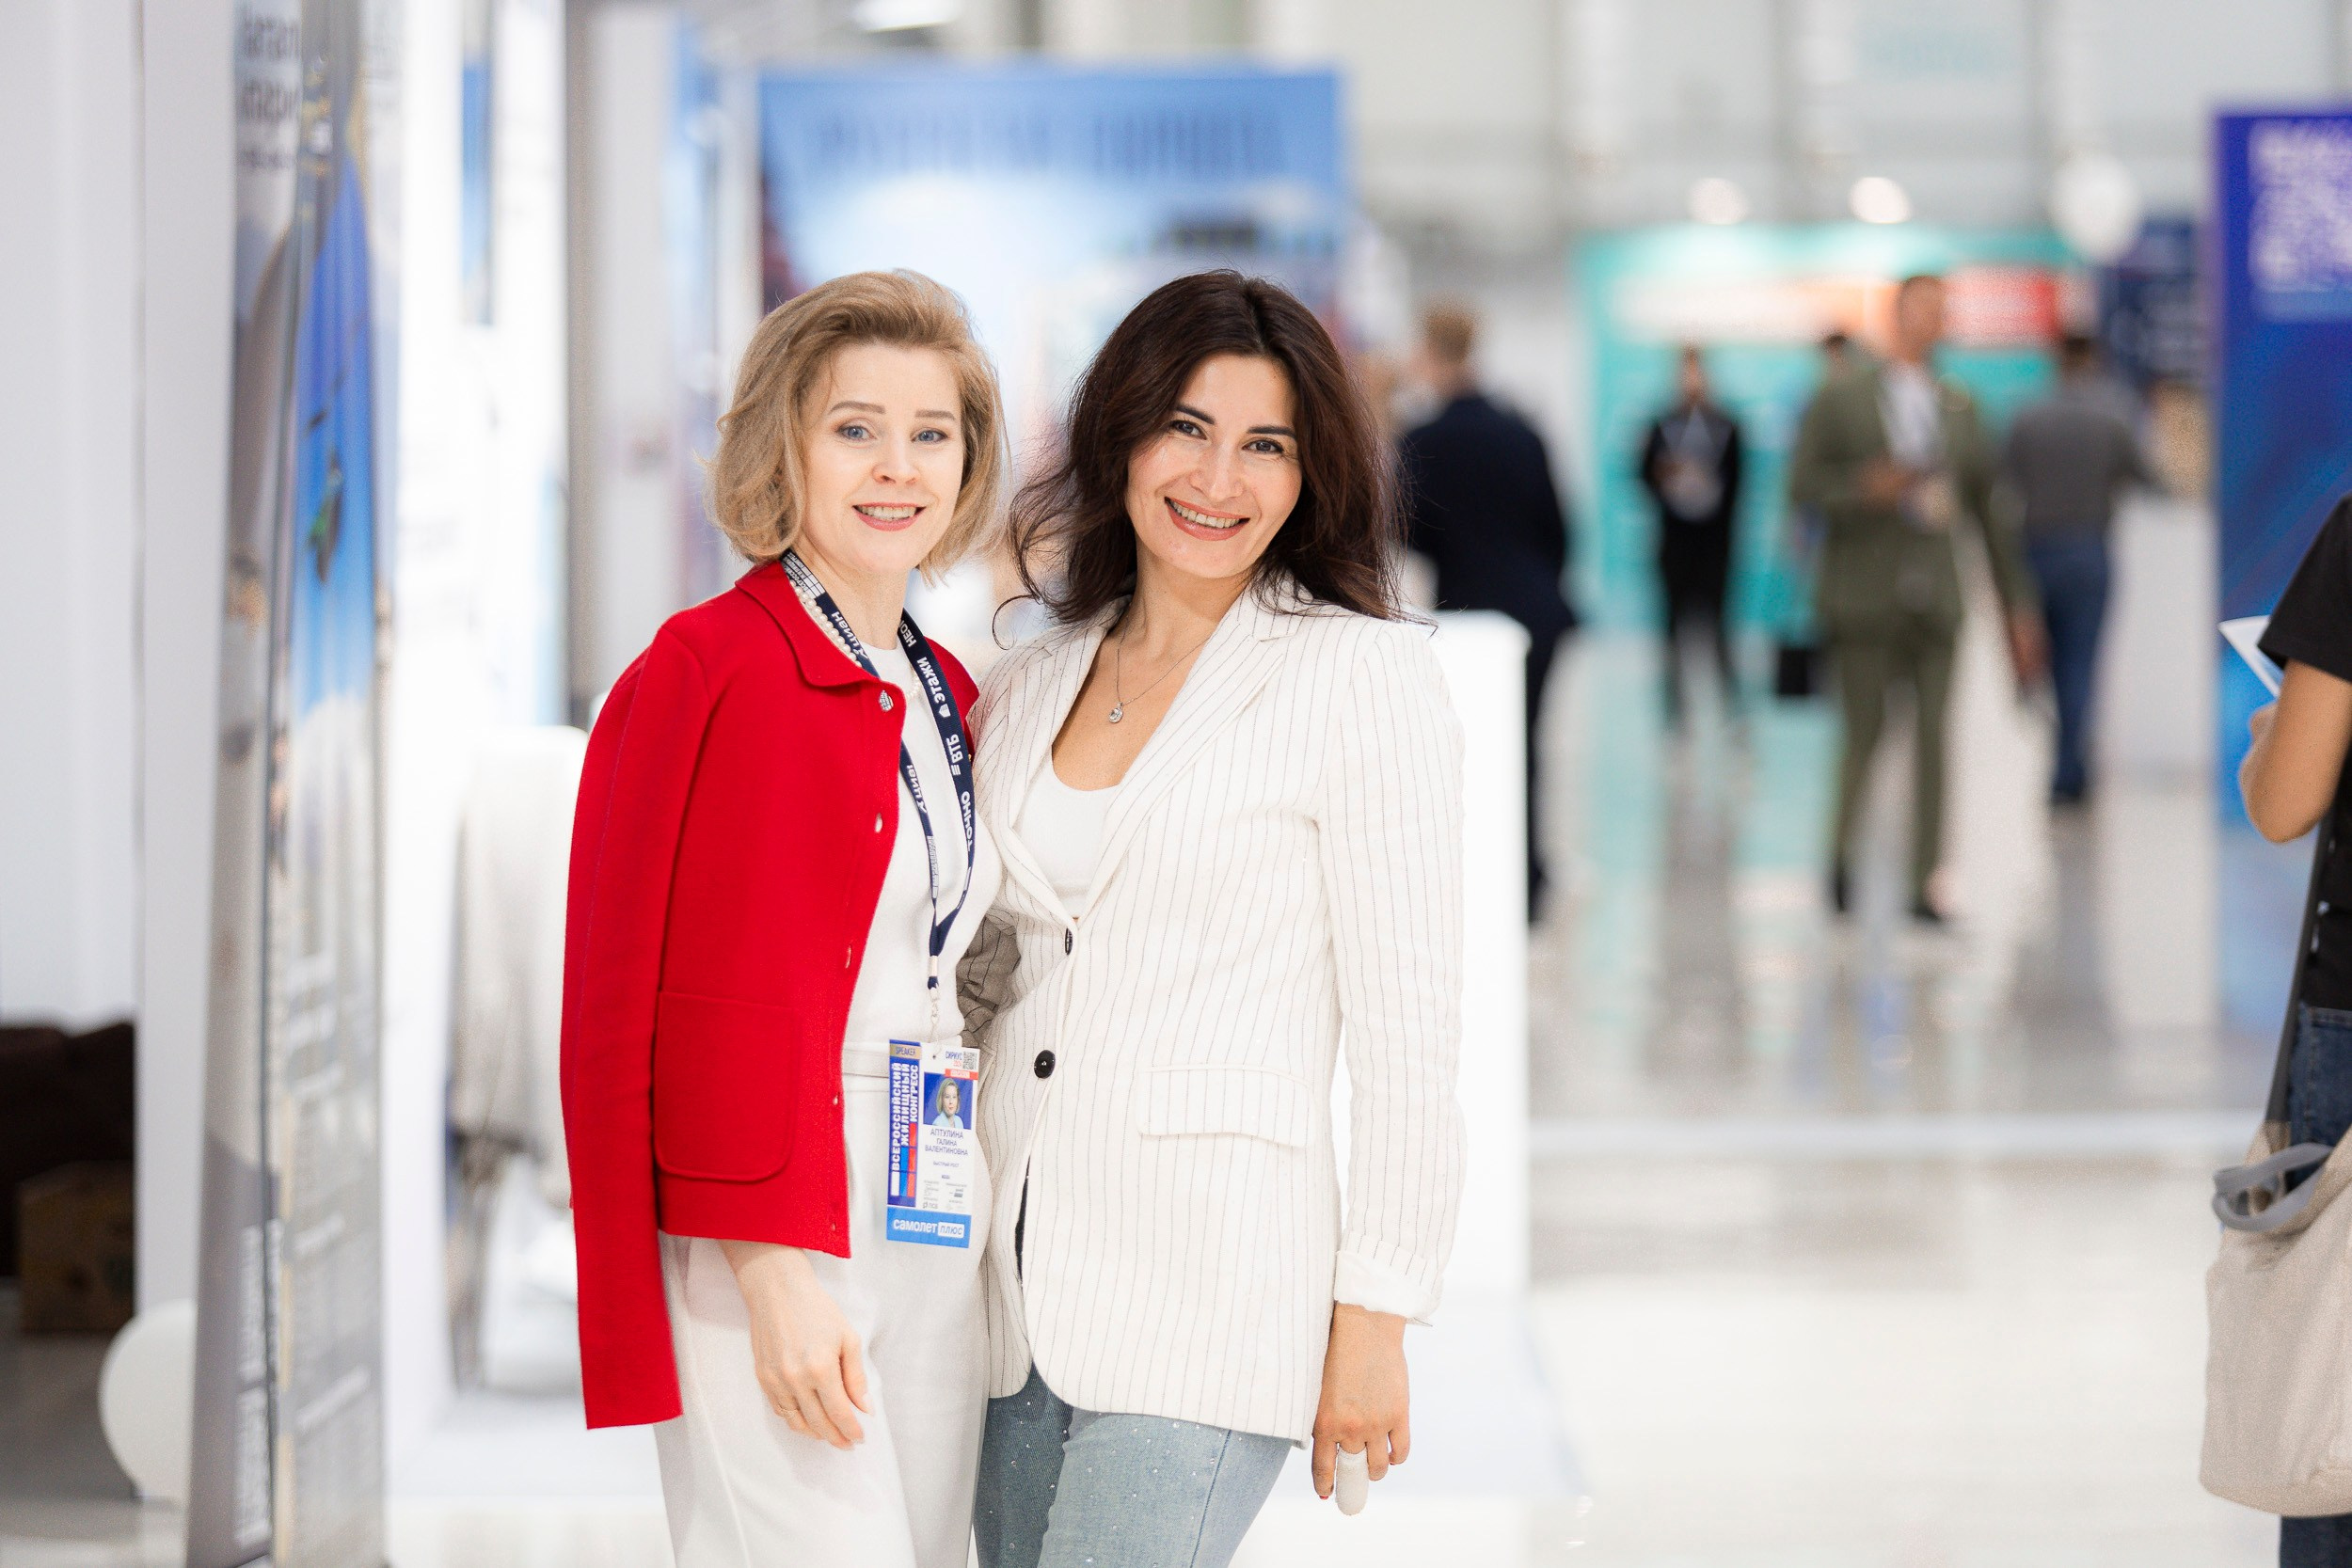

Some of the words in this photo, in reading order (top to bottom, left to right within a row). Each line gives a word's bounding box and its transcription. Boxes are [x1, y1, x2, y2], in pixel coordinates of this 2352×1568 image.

[946, 734, 963, 764] ВТБ
[900, 1063, 910, 1147] ЖИЛИЩНЫЙ
[910, 1064, 918, 1122] КОНГРЕСС
[891, 1062, 901, 1171] ВСЕРОССИЙСКИЙ
[930, 1128, 963, 1139] АПТУЛИНА
[936, 1137, 958, 1147] ГАЛИНА
[925, 1145, 968, 1155] ВАЛЕНТИНОВНА
